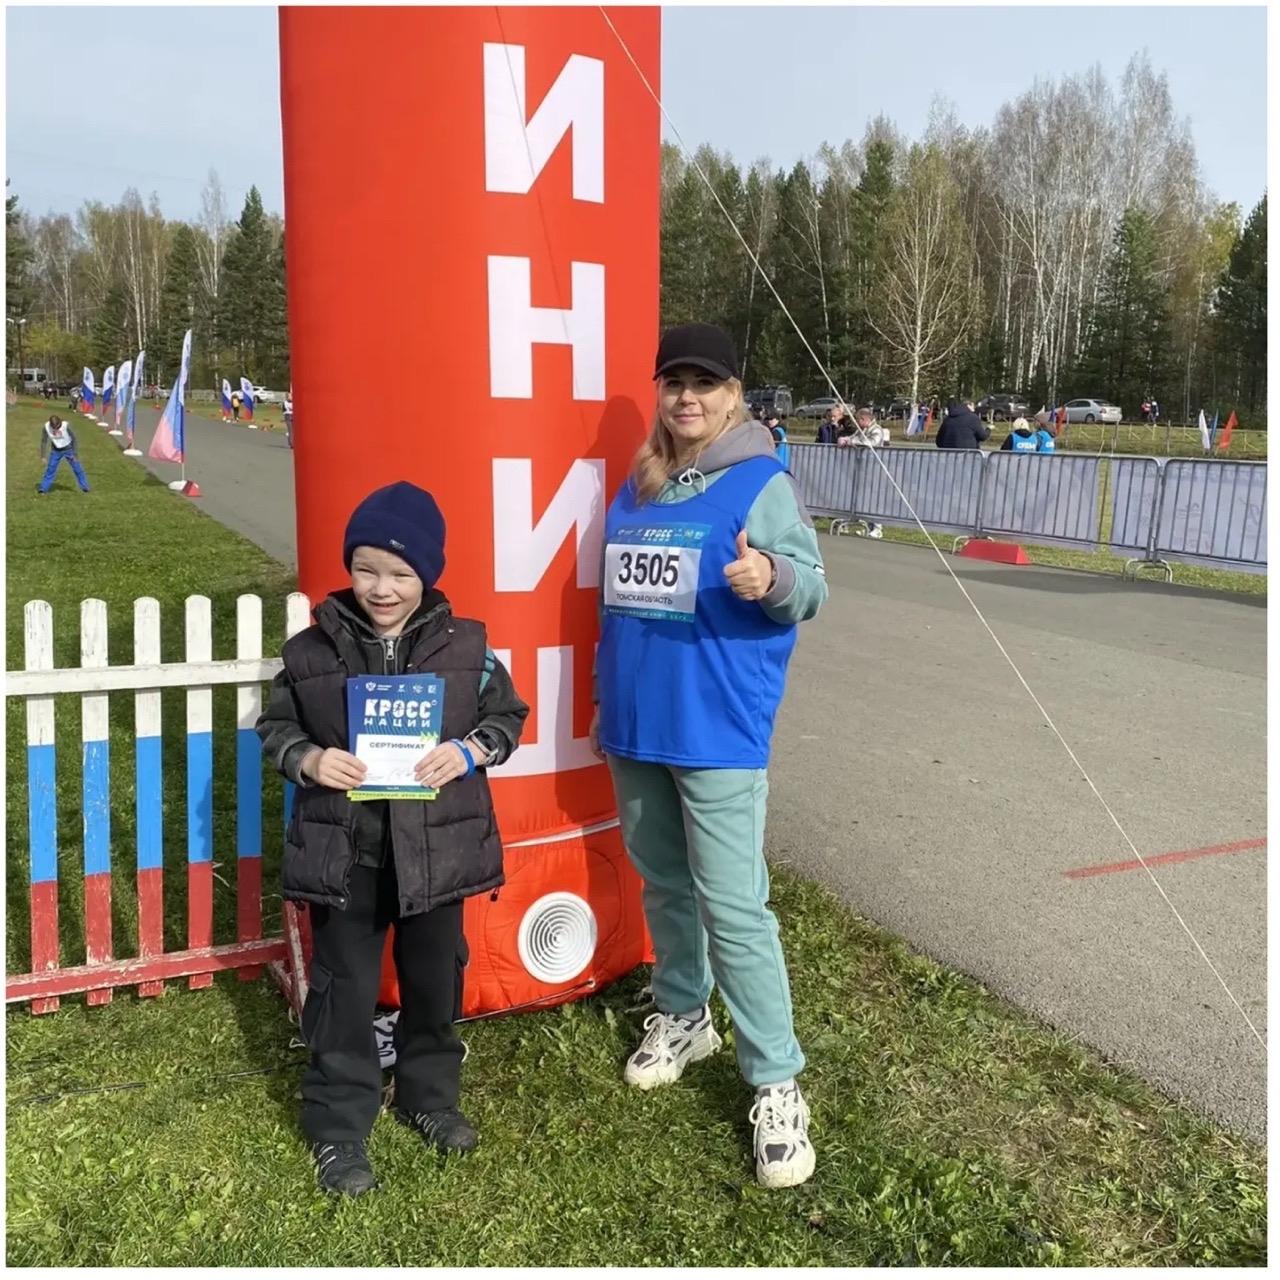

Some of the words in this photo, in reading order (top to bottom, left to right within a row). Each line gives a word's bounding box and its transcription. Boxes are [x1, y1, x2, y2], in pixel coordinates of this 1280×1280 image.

[643, 528, 673, 538] КРОСС
[618, 551, 680, 588] 3505
[364, 698, 432, 719] КРОСС
[363, 717, 431, 728] НАЦИИ
[369, 741, 426, 750] СЕРТИФИКАТ
